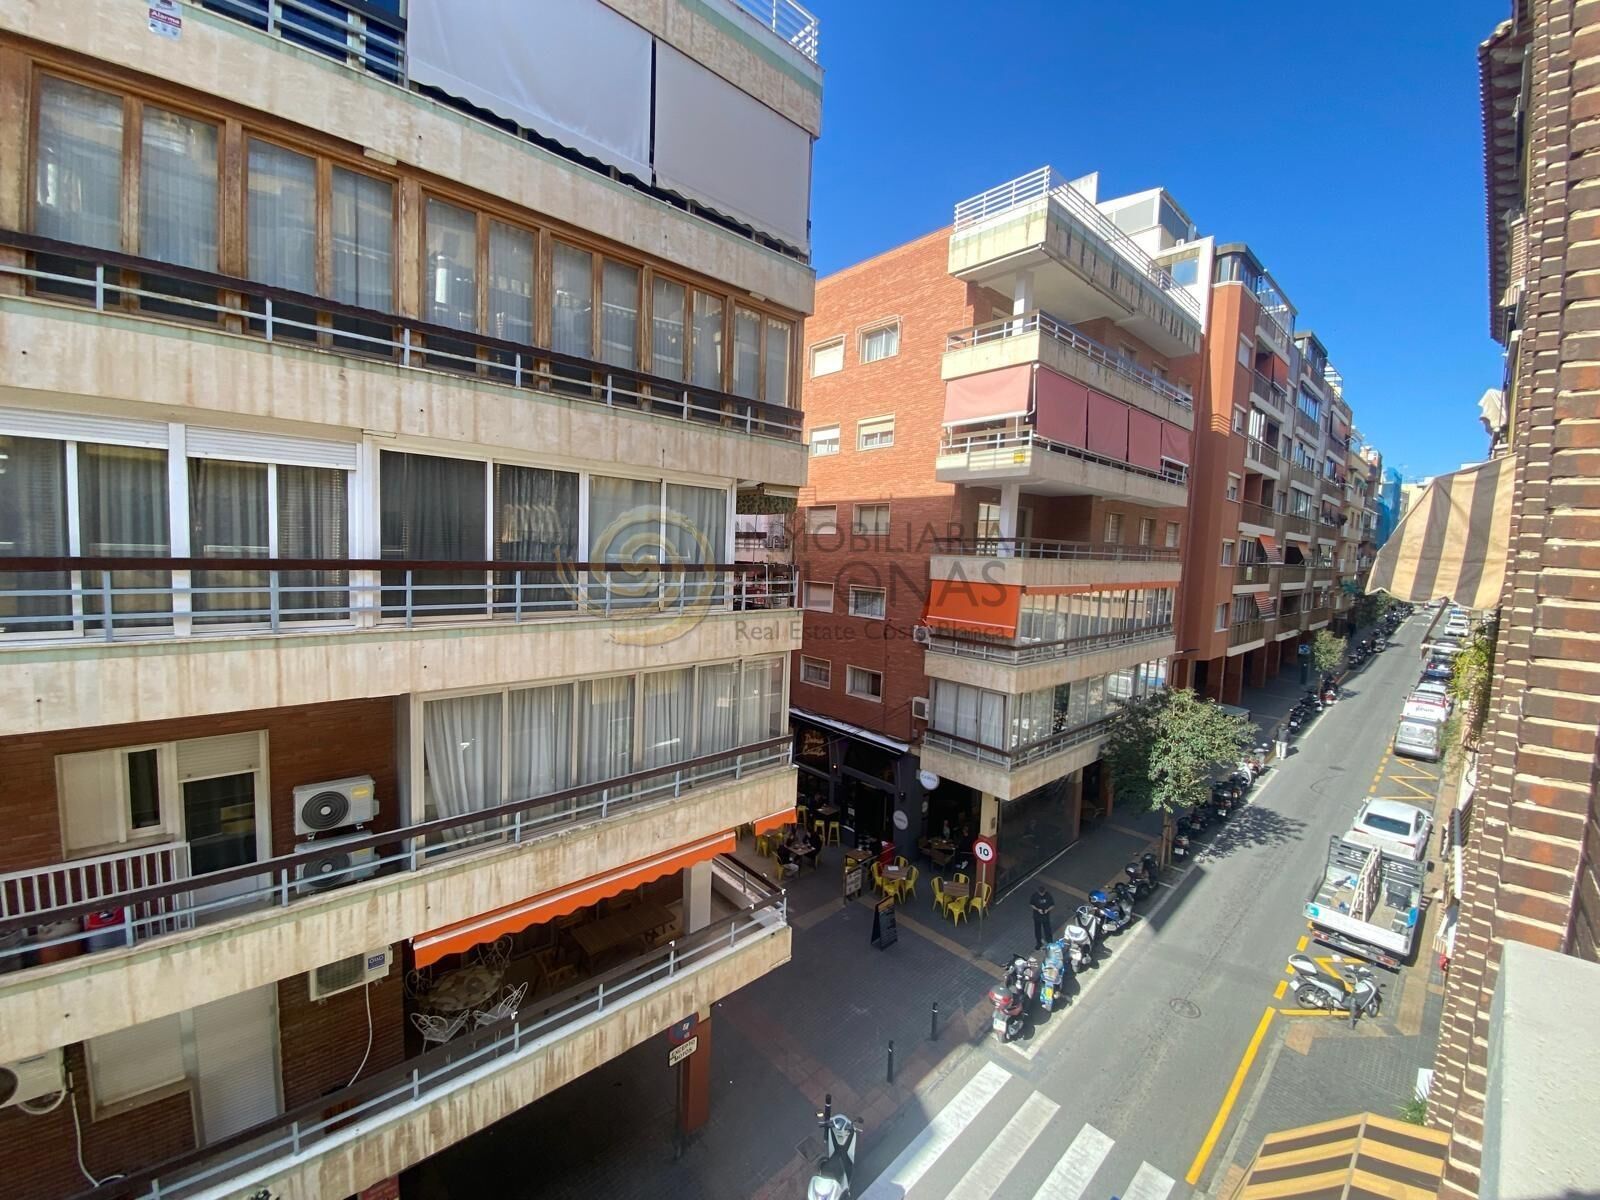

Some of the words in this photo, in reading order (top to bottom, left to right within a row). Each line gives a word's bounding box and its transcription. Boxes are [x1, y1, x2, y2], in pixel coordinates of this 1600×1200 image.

[978, 846, 990, 857] 10
[671, 1038, 696, 1057] EXCEPTO
[674, 1047, 693, 1062] MOTOS
